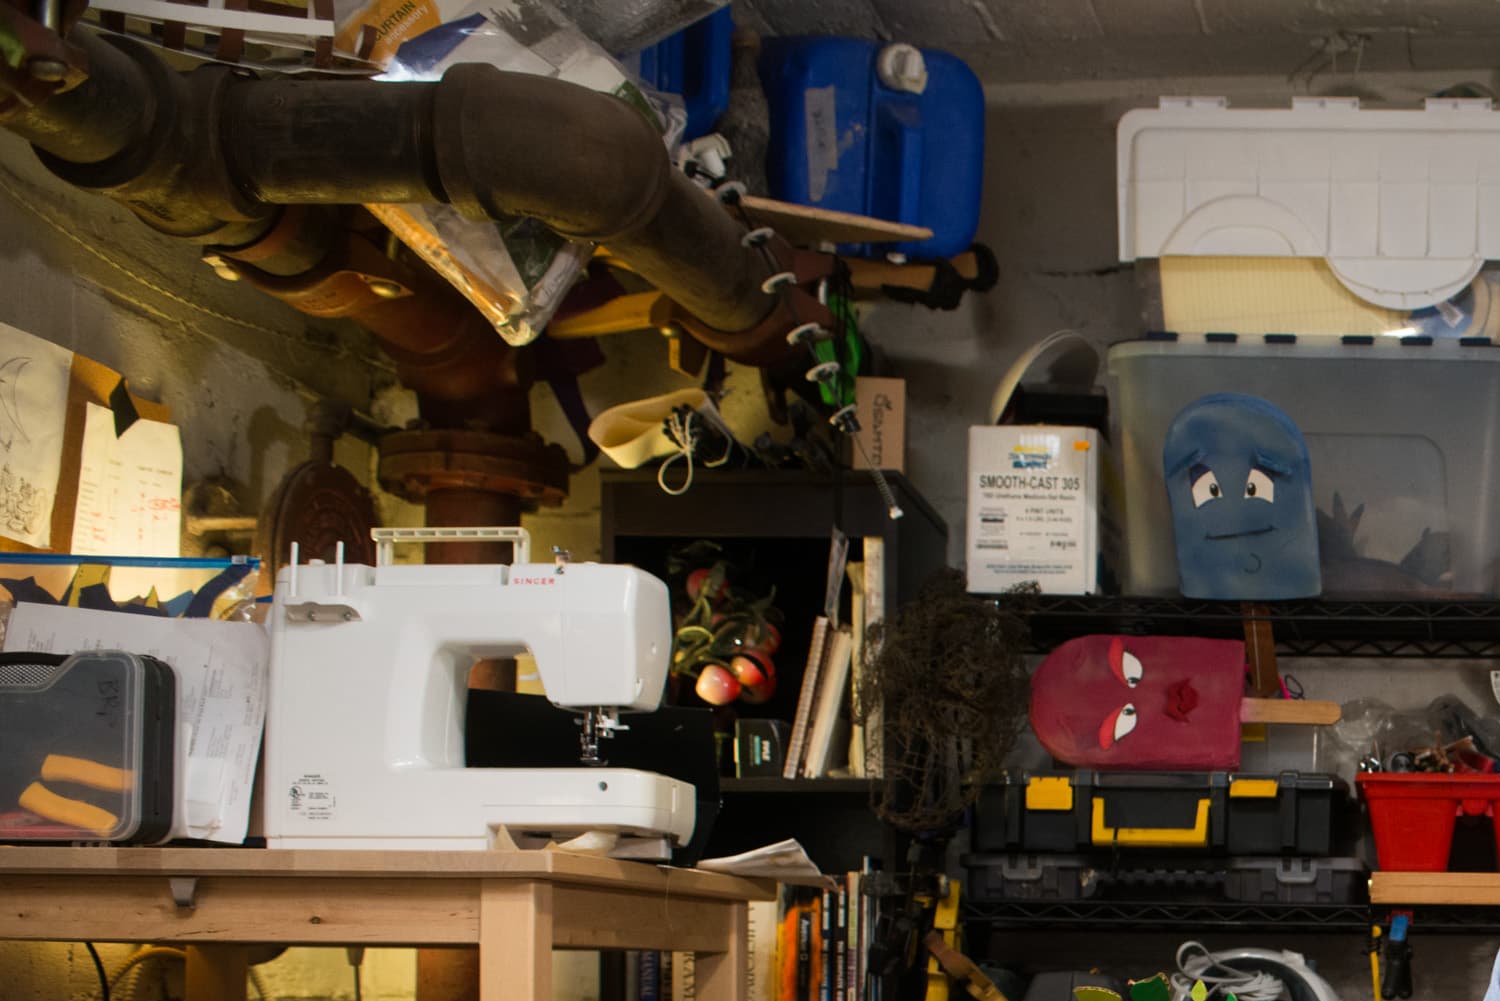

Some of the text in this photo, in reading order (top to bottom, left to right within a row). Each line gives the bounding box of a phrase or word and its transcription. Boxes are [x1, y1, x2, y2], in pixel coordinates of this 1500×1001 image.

[980, 475, 1081, 490] SMOOTH-CAST 305
[513, 577, 556, 585] SINGER
